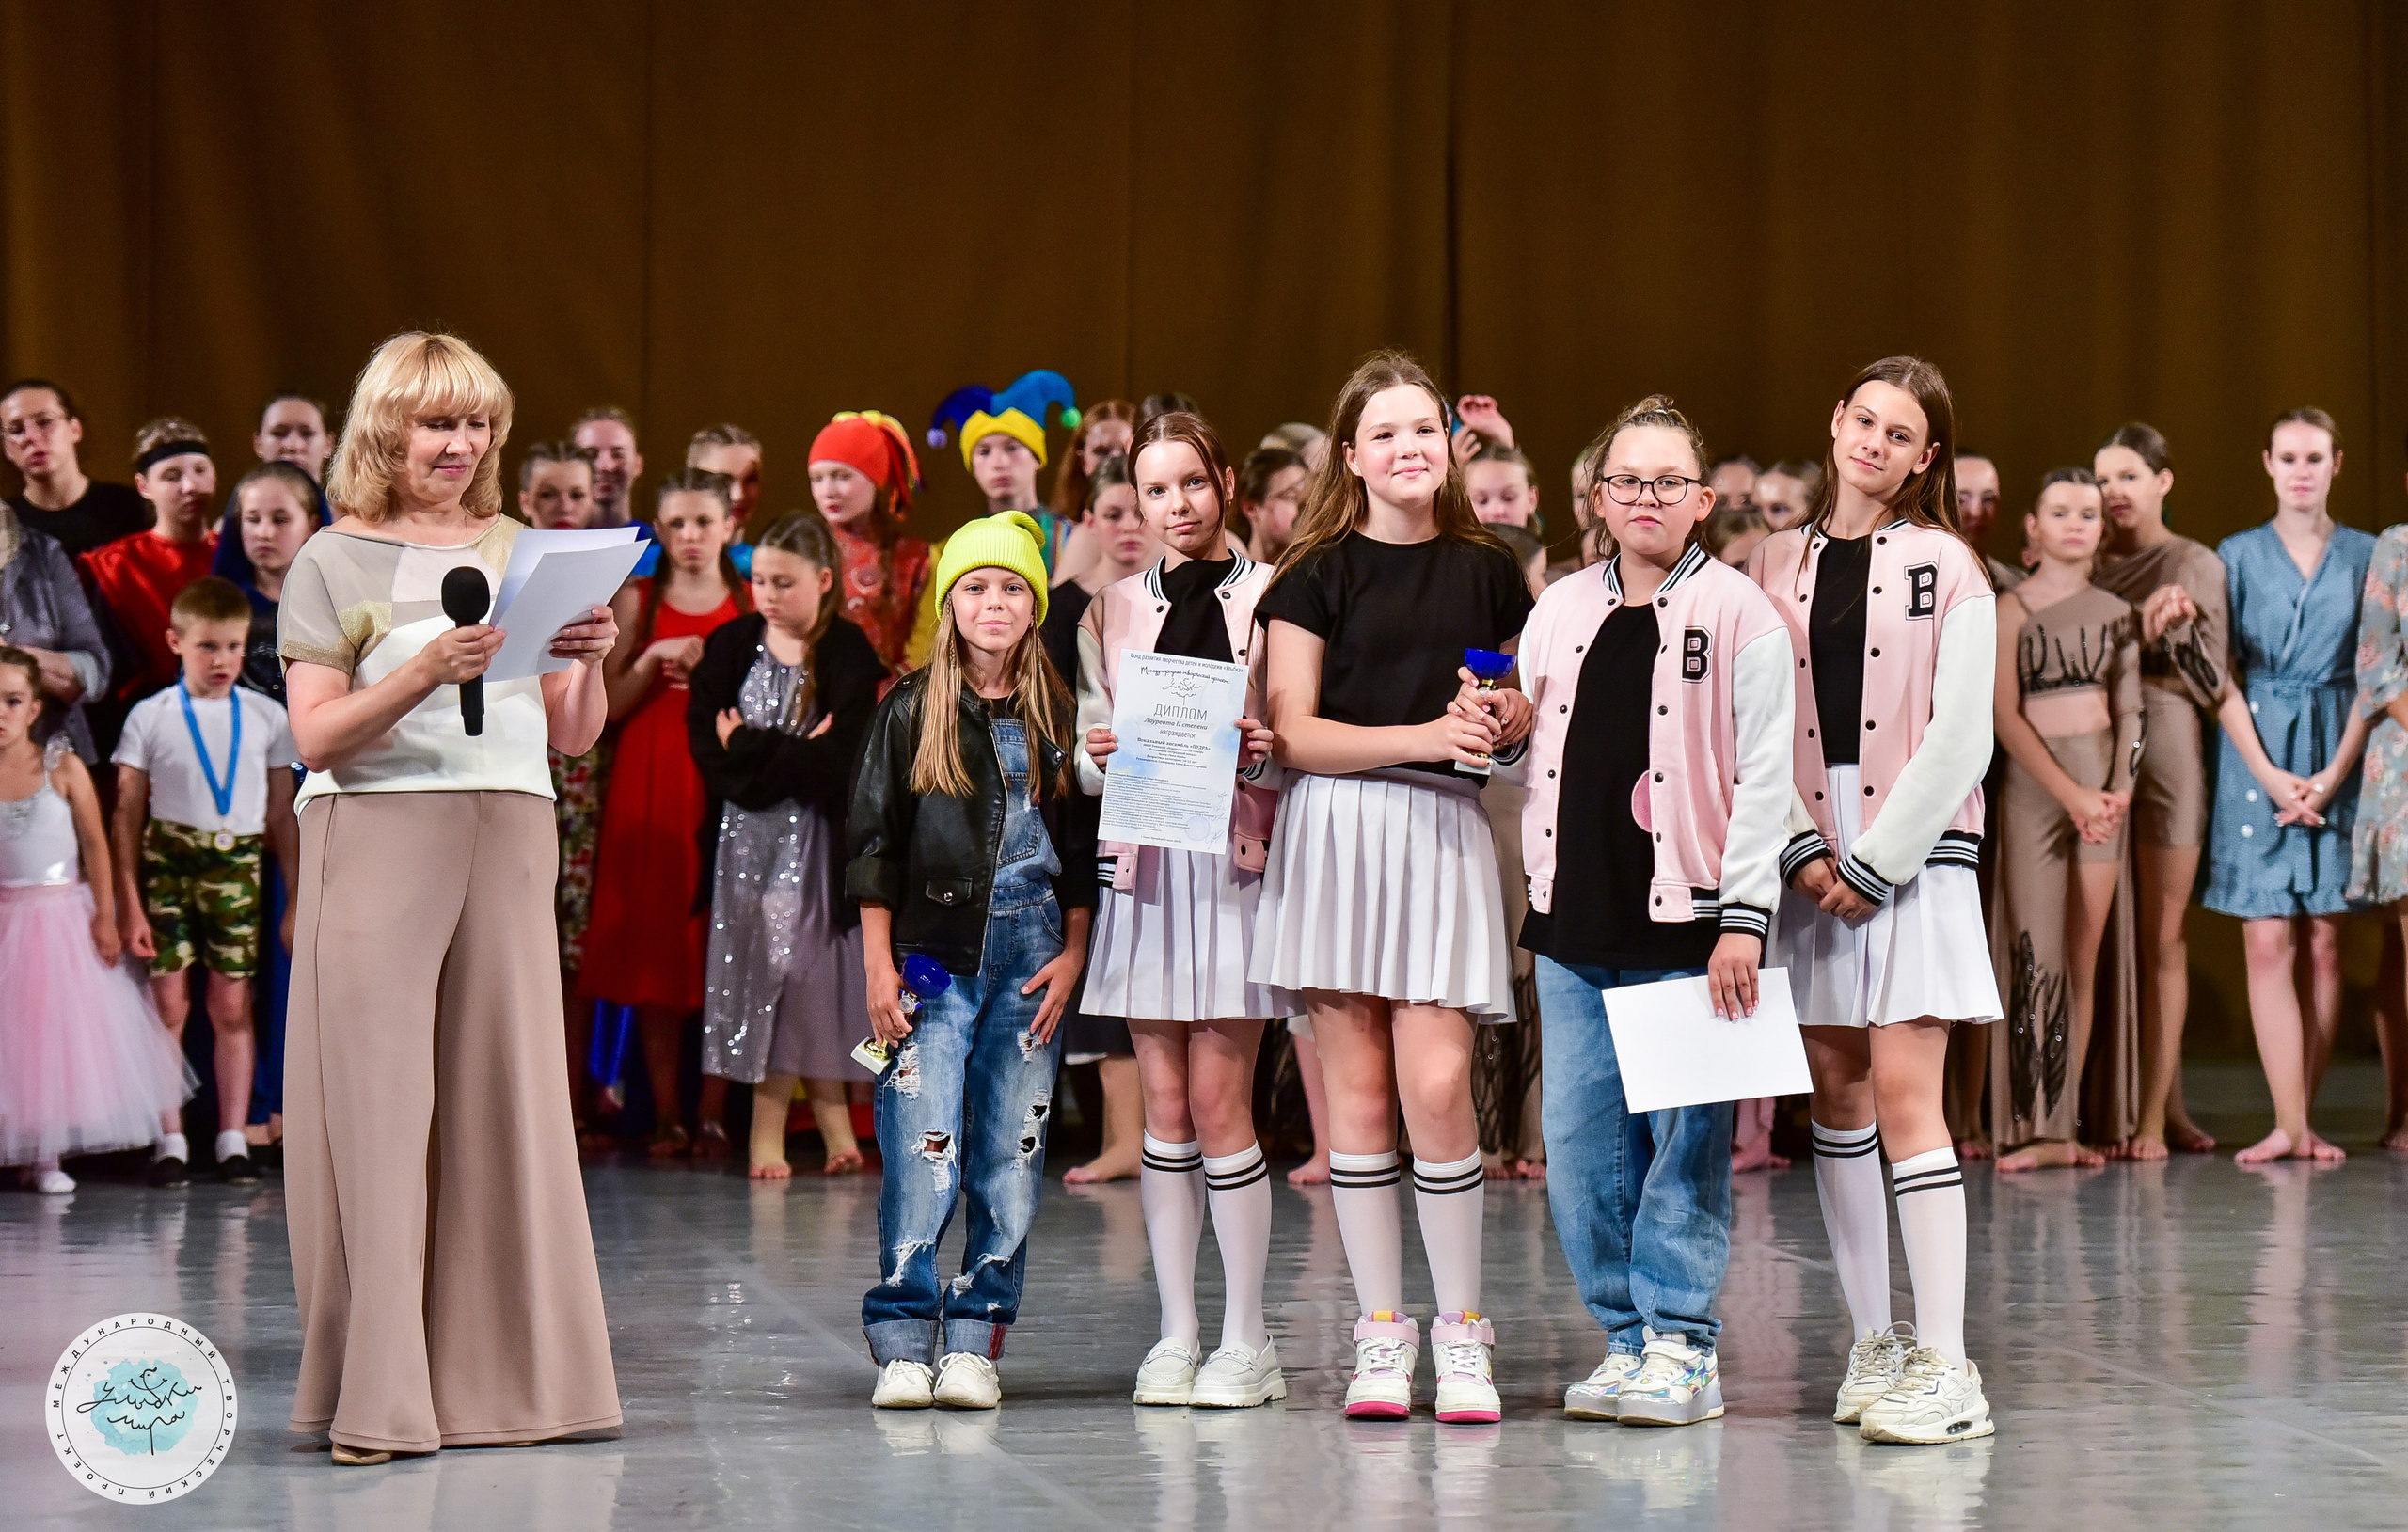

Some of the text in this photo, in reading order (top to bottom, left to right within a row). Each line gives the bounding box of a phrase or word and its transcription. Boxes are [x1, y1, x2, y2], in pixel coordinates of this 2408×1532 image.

[1904, 561, 1938, 621] B
[1162, 656, 1185, 665] творчества
[1682, 625, 1713, 685] B
[1140, 666, 1182, 677] Международный
[1153, 703, 1208, 721] ДИПЛОМ
[1144, 717, 1175, 726] Лауреата
[1181, 722, 1208, 731] степени
[1159, 729, 1196, 739] награждается
[1137, 736, 1165, 745] Вокальный
